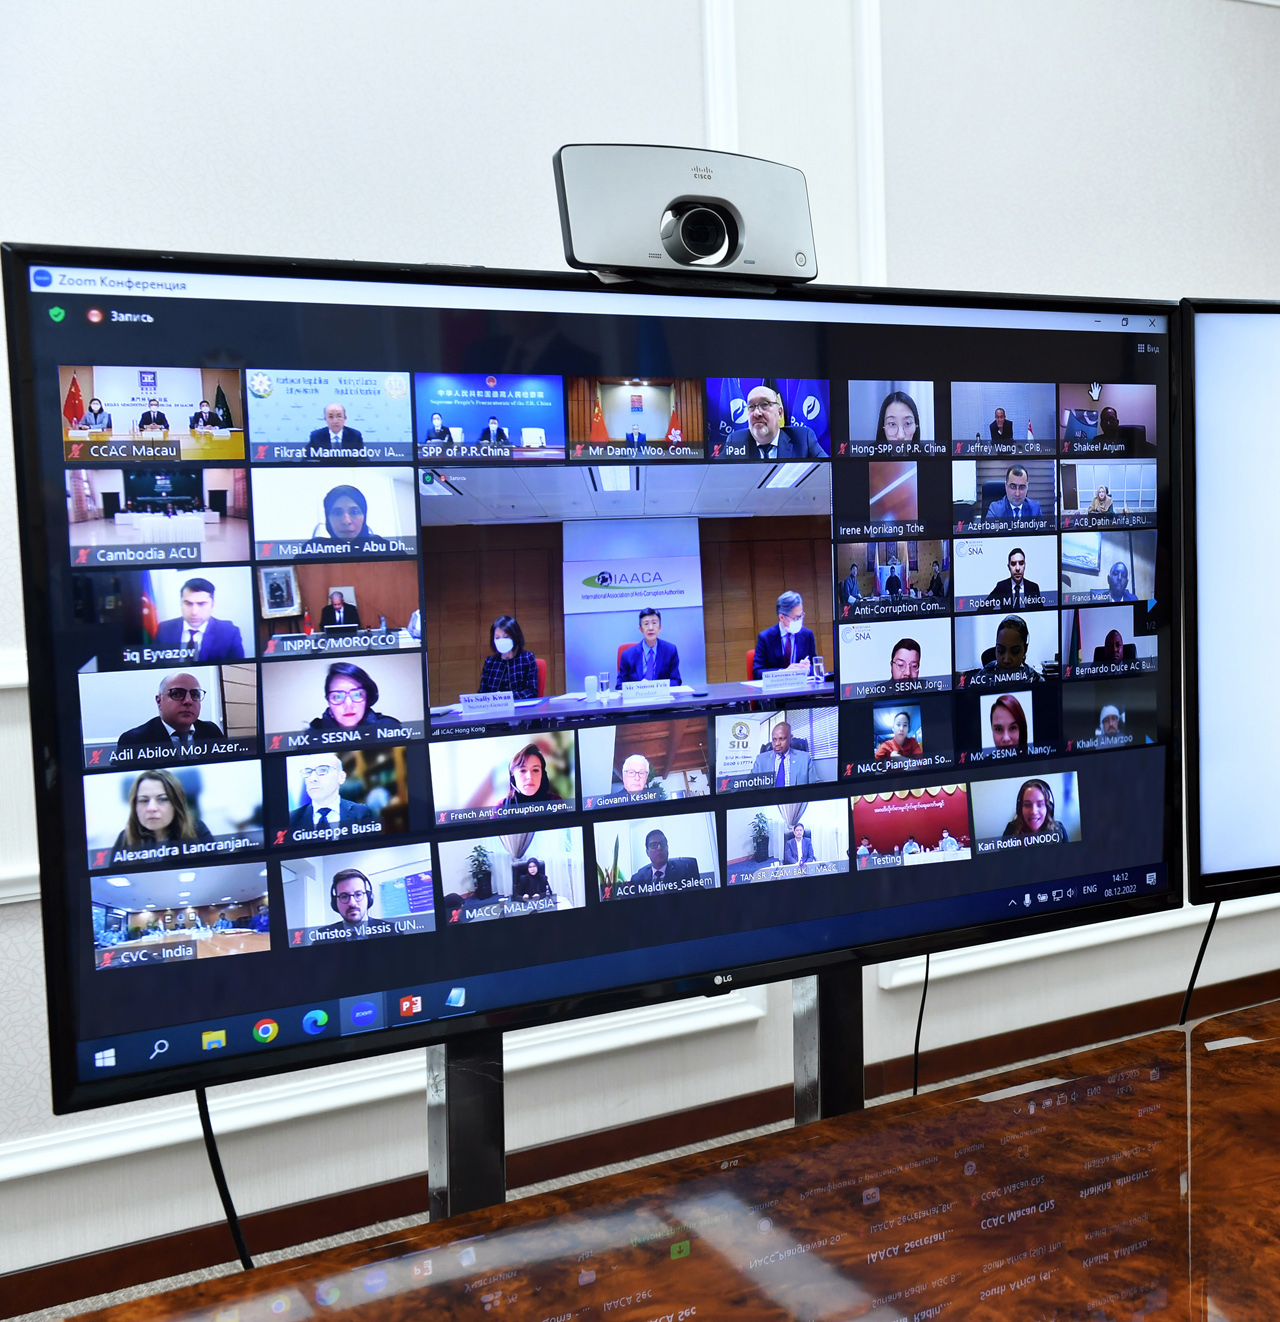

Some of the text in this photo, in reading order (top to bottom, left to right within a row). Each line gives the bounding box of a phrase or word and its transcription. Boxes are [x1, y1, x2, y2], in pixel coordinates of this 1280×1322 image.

[58, 274, 97, 287] Zoom
[100, 277, 186, 291] Конференция
[111, 310, 154, 324] Запись
[90, 443, 176, 457] CCAC Macau
[274, 446, 307, 459] Fikrat
[310, 445, 381, 458] Mammadov
[422, 445, 510, 457] SPP of P.R.China
[589, 445, 699, 459] Mr Danny Woo, Com...
[725, 445, 747, 456] iPad
[851, 443, 947, 456] Hong-SPP of P.R. China
[967, 442, 992, 455] Jeffrey
[994, 443, 1016, 455] Wang
[1073, 441, 1125, 453] Shakeel Anjum
[840, 522, 924, 536] Irene Morikang Tche
[96, 547, 197, 562] Cambodia ACU
[279, 541, 414, 555] Mai.AlAmeri Abu Dh...
[614, 572, 663, 584] IAACA
[969, 594, 1045, 607] Roberto M México
[854, 602, 945, 615] Anti-Corruption Com...
[283, 634, 396, 651] INPPLC/MOROCCO
[143, 647, 195, 661] Eyvazov
[1076, 664, 1108, 675] Bernardo
[1110, 663, 1128, 673] Duce
[1130, 662, 1139, 671] AC
[969, 672, 1027, 685] ACC NAMIBIA
[856, 679, 949, 695] Mexico SESNA Jorg...
[288, 727, 420, 746] MX SESNA Nancy...
[471, 726, 486, 734] Kong
[729, 740, 750, 750] SIU
[1076, 738, 1098, 749] Khalid
[108, 742, 248, 762] Adil Abilov MoJ Azer...
[970, 745, 1057, 762] MX SESNA Nancy...
[857, 755, 952, 773] NACC_Piangtawan So...
[733, 775, 774, 789] amothibi
[597, 791, 656, 807] Giovanni Kessler
[450, 802, 573, 821] French Anti-Corruuption Agen...
[293, 821, 382, 842] Giuseppe Busia
[978, 832, 1060, 851] Kari Rotkin (UNODC)
[113, 836, 259, 863] Alexandra Lancranjan...
[872, 854, 902, 866] Testing
[1112, 872, 1129, 882] 14:12
[616, 876, 712, 896] ACC Maldives_Saleem
[1082, 884, 1097, 894] ENG
[1104, 885, 1137, 897] 08.12.2022
[465, 899, 554, 920] MACC, MALAYSIA
[308, 926, 351, 941] Christos
[354, 922, 392, 936] Vlassis
[120, 944, 193, 963] CVC India
[723, 975, 732, 983] LG
